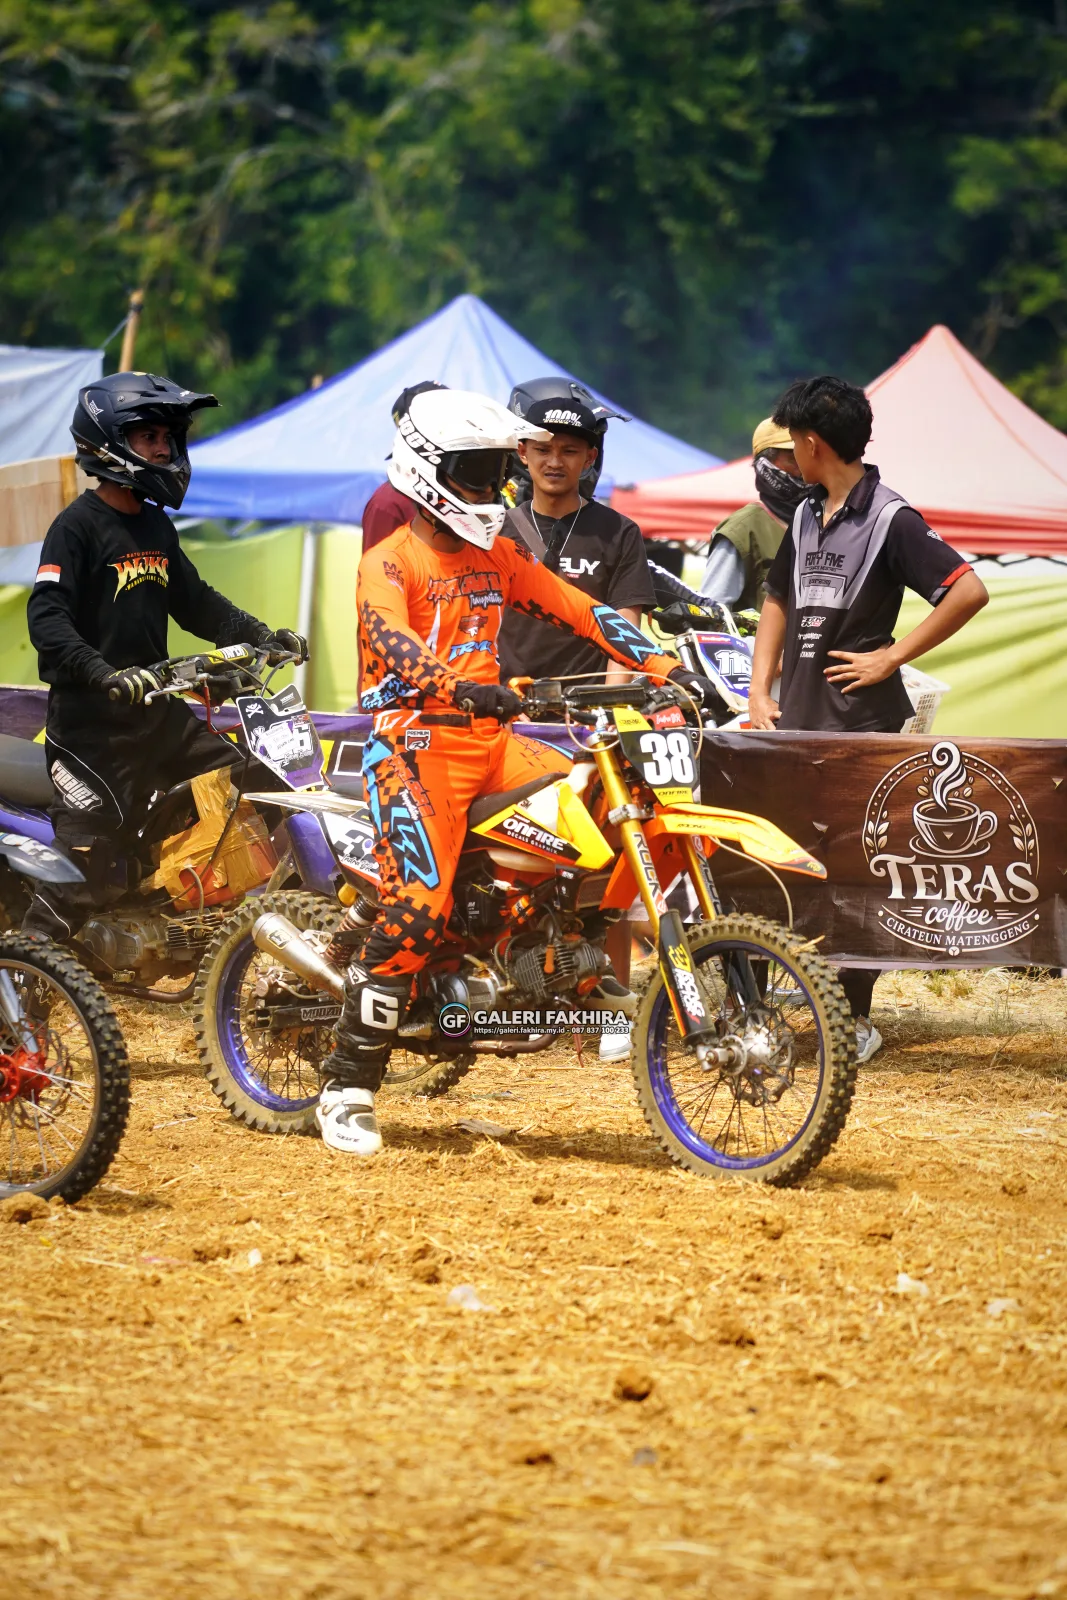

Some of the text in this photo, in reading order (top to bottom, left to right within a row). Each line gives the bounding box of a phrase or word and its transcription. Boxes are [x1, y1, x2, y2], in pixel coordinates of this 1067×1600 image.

[544, 409, 582, 424] 100%
[413, 475, 466, 516] KYT
[824, 552, 846, 568] FIVE
[640, 732, 694, 785] 38
[502, 818, 568, 851] ONFIRE
[507, 830, 529, 843] DECALS
[634, 833, 660, 898] ROCK
[870, 854, 1039, 904] TERAS
[886, 917, 1031, 946] CIRATEUN MATENGGENG
[925, 901, 993, 931] coffee
[361, 987, 399, 1031] G
